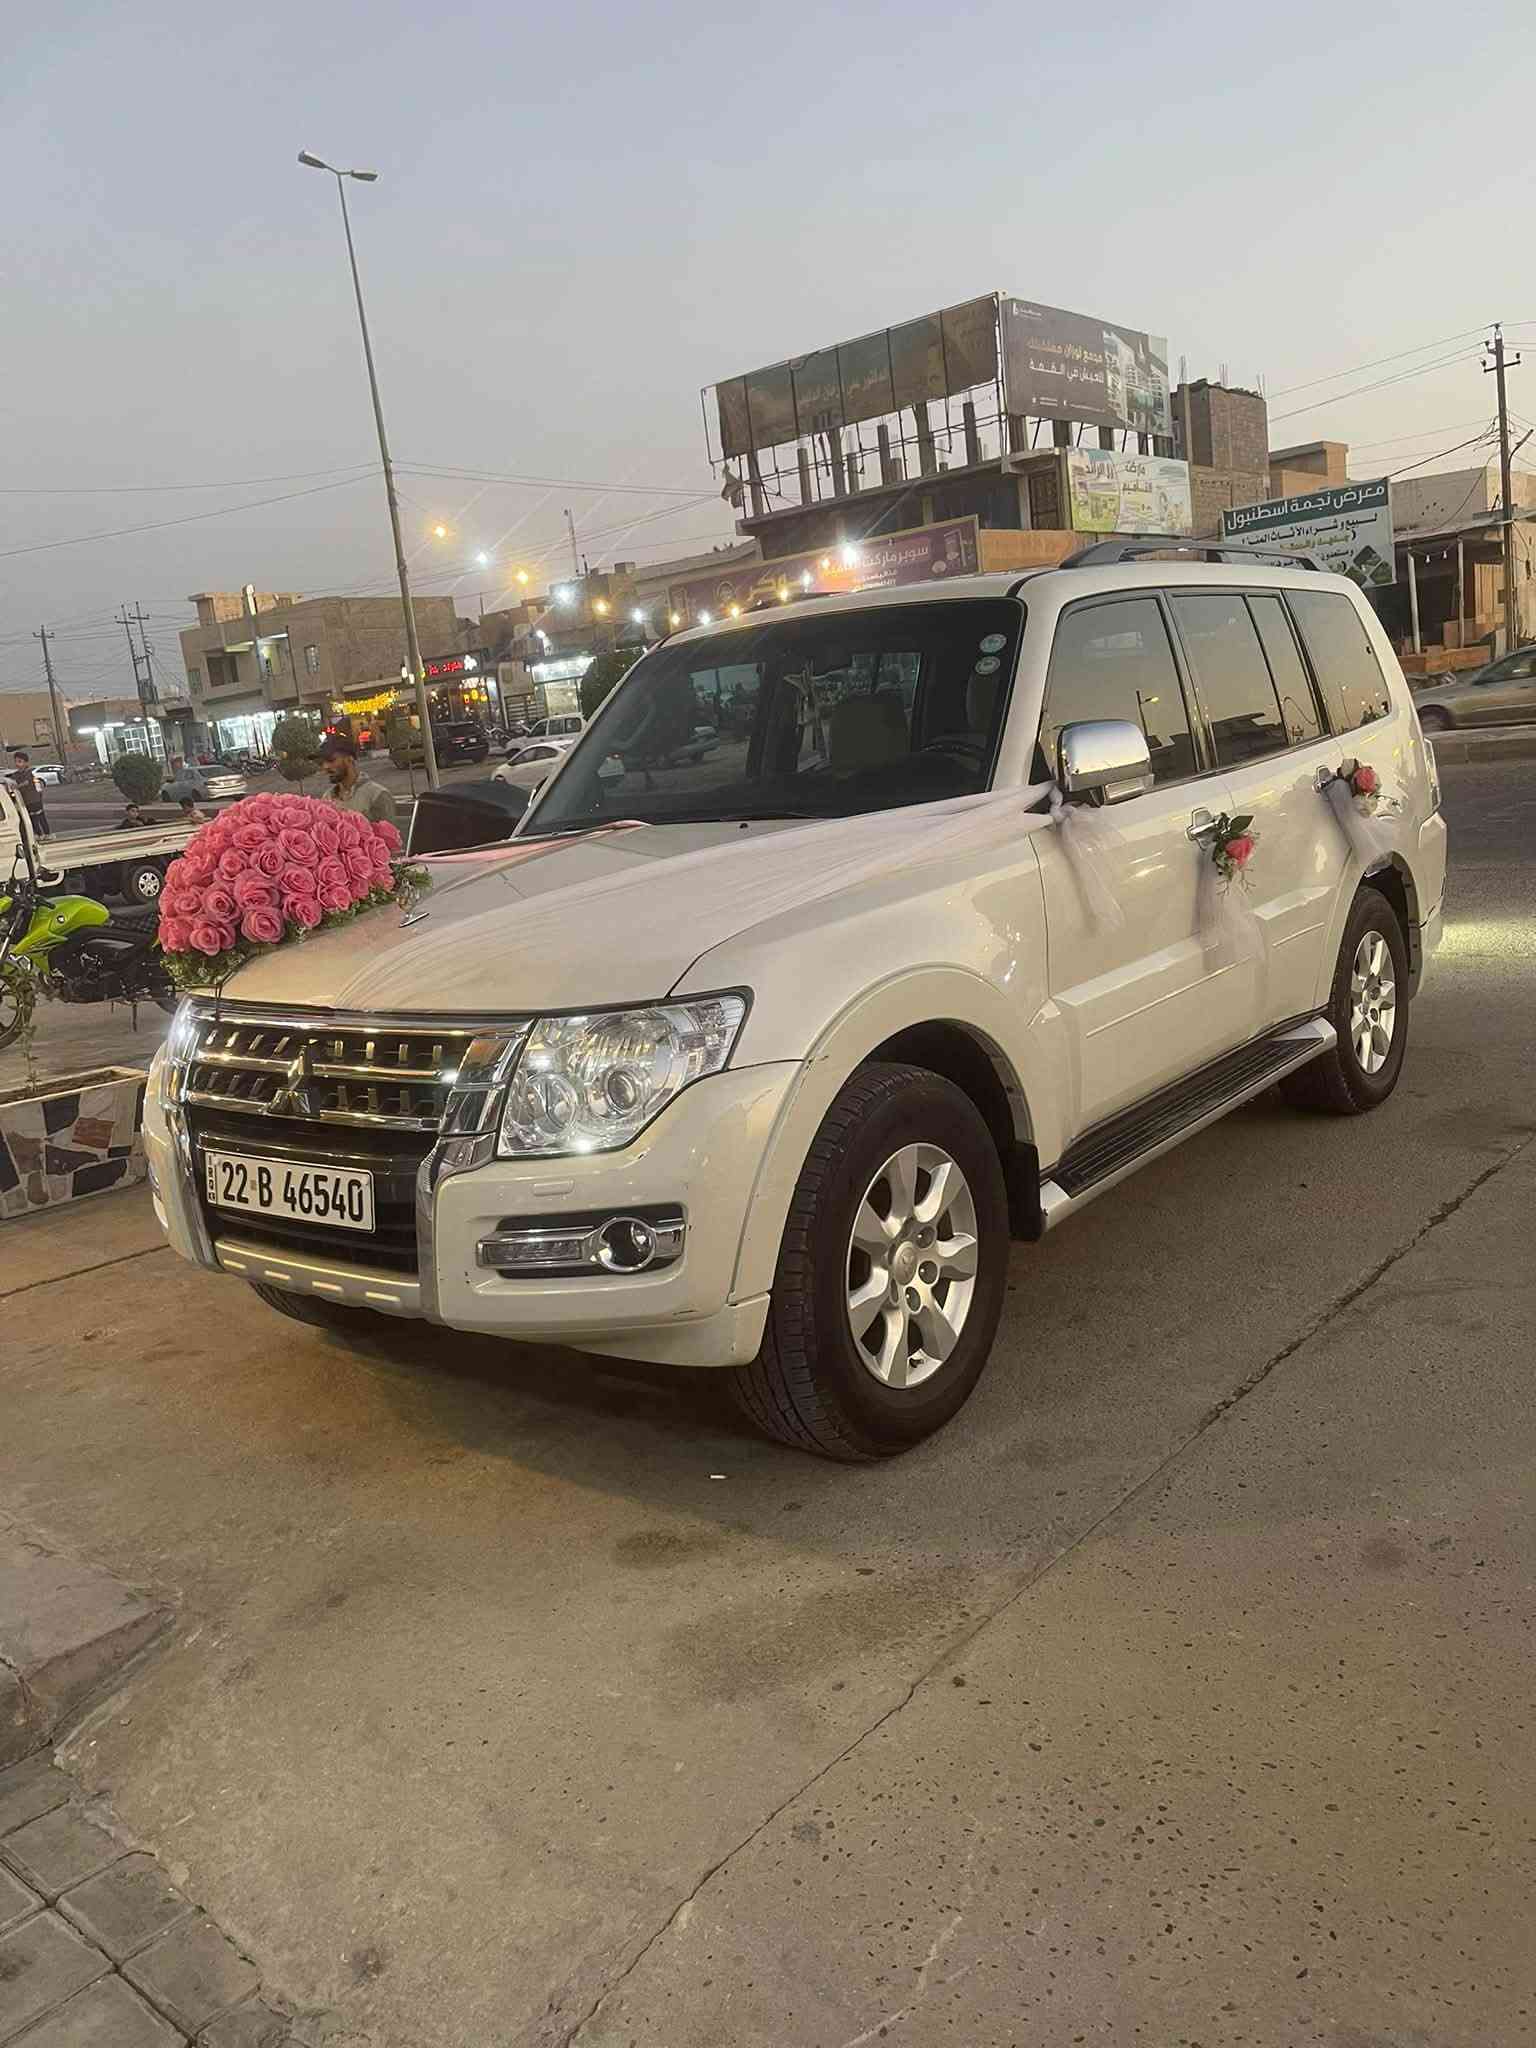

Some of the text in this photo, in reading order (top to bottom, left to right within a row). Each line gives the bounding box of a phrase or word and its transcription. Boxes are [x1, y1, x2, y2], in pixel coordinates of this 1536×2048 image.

[1227, 485, 1385, 530] معرض نجمة اسطنبول
[897, 547, 929, 564] سوبر
[222, 1161, 364, 1222] 22 B 46540
